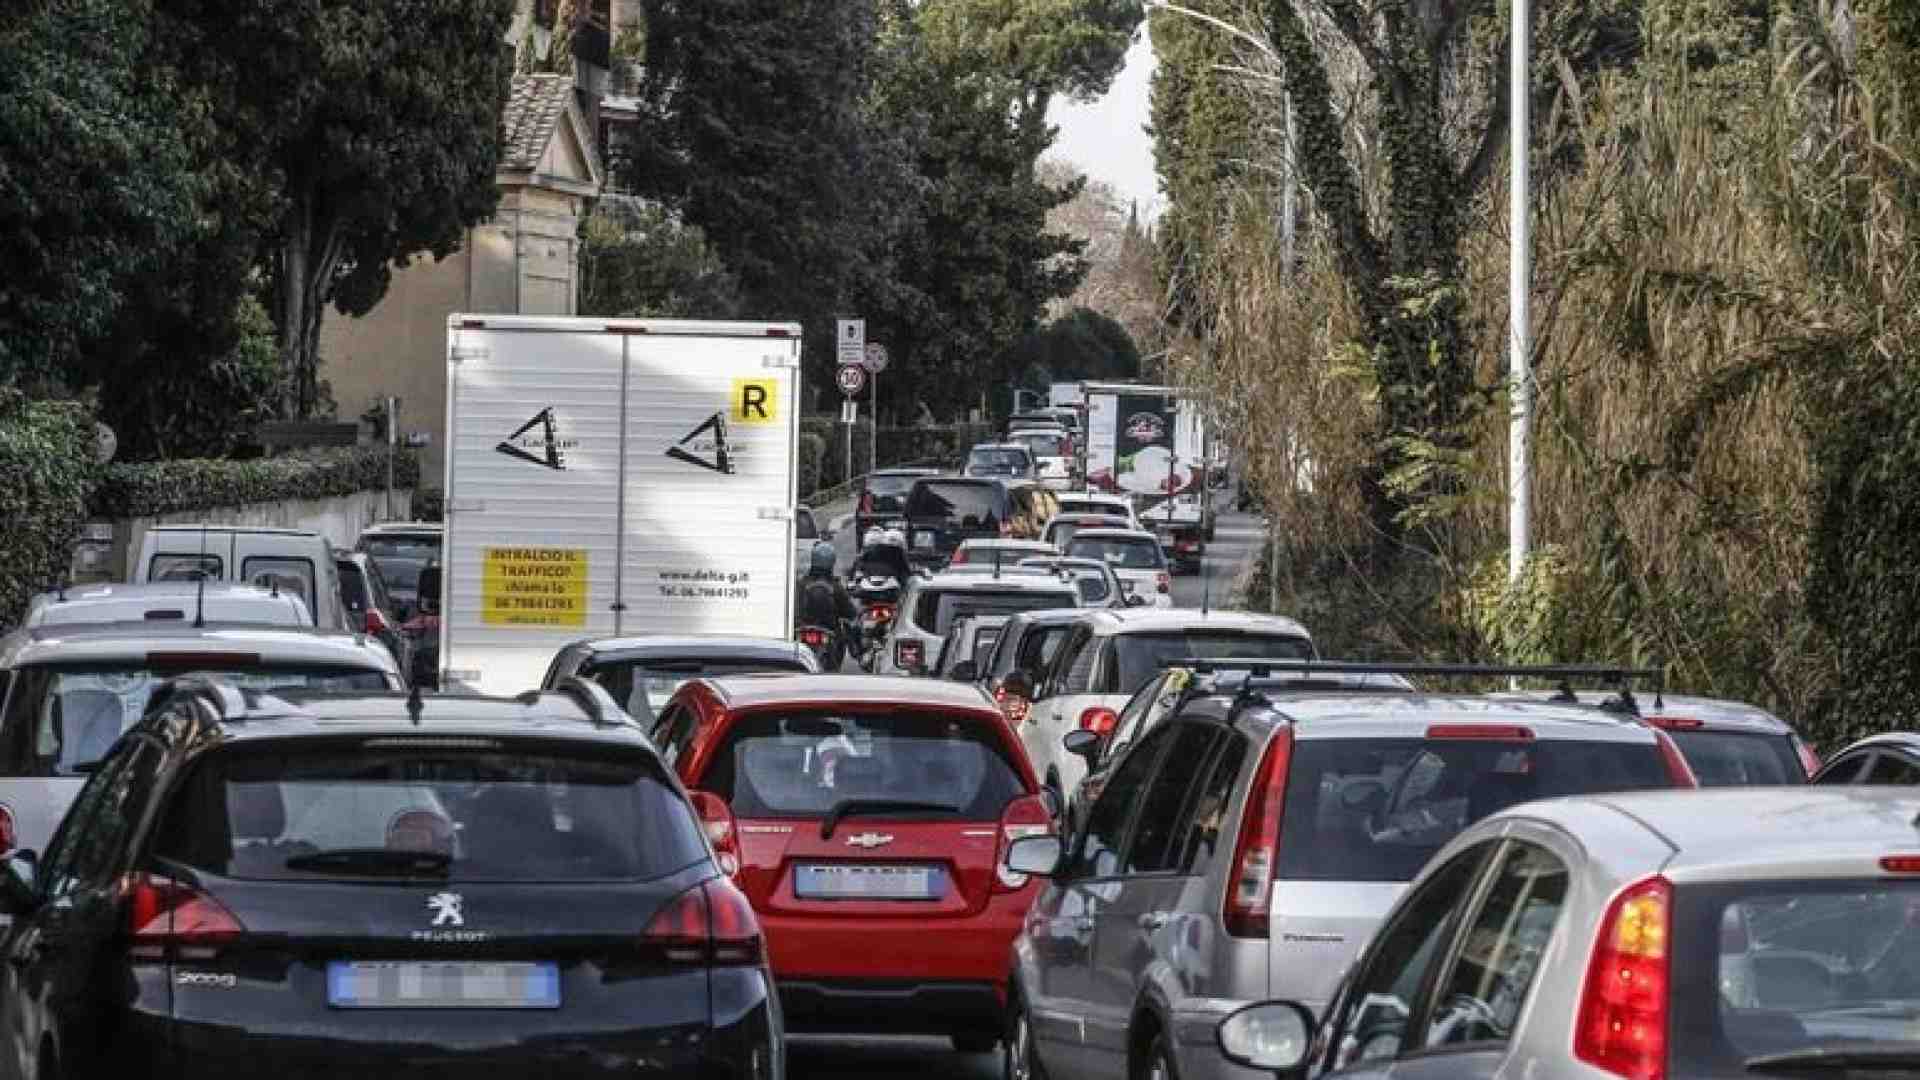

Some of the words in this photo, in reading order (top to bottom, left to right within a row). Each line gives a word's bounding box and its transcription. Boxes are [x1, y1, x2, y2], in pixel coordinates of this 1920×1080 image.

[743, 384, 767, 418] R
[501, 565, 572, 577] TRAFFICO?
[506, 580, 548, 592] chiama
